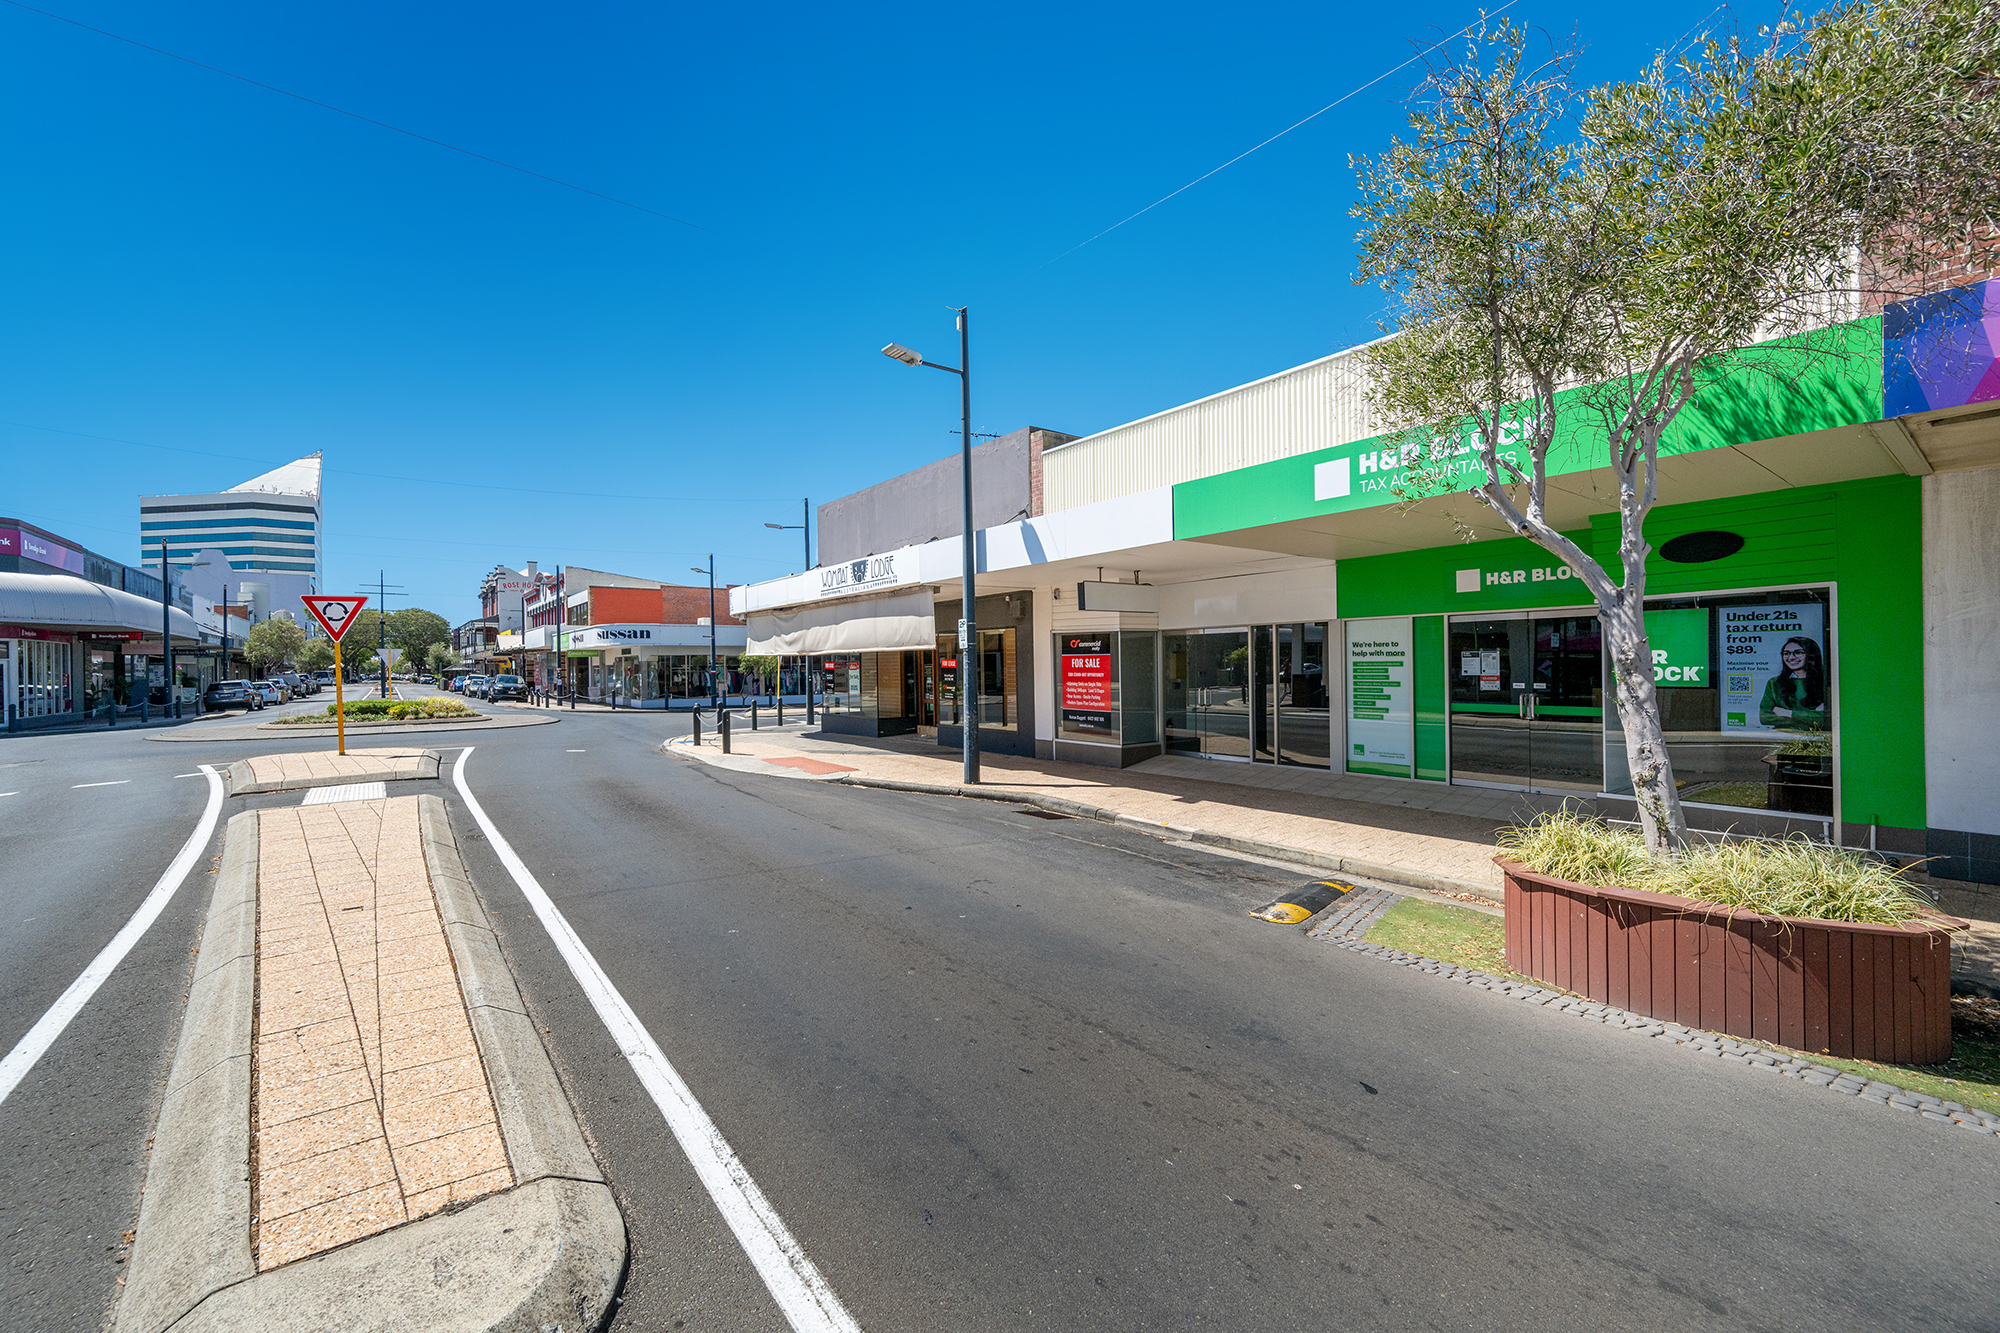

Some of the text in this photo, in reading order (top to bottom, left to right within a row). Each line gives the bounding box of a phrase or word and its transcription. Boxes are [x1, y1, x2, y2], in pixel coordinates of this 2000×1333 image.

[1359, 443, 1421, 475] H&R
[1359, 476, 1387, 493] TAX
[820, 555, 895, 588] WOMBAT LODGE
[1486, 570, 1526, 585] H&R
[502, 581, 520, 589] ROSE
[1726, 610, 1798, 622] Under 21s
[1726, 622, 1803, 633] tax return
[597, 629, 651, 640] sussan
[1726, 633, 1763, 643] from
[1373, 640, 1390, 648] here
[1352, 650, 1368, 658] help
[1071, 658, 1101, 668] FOR SALE
